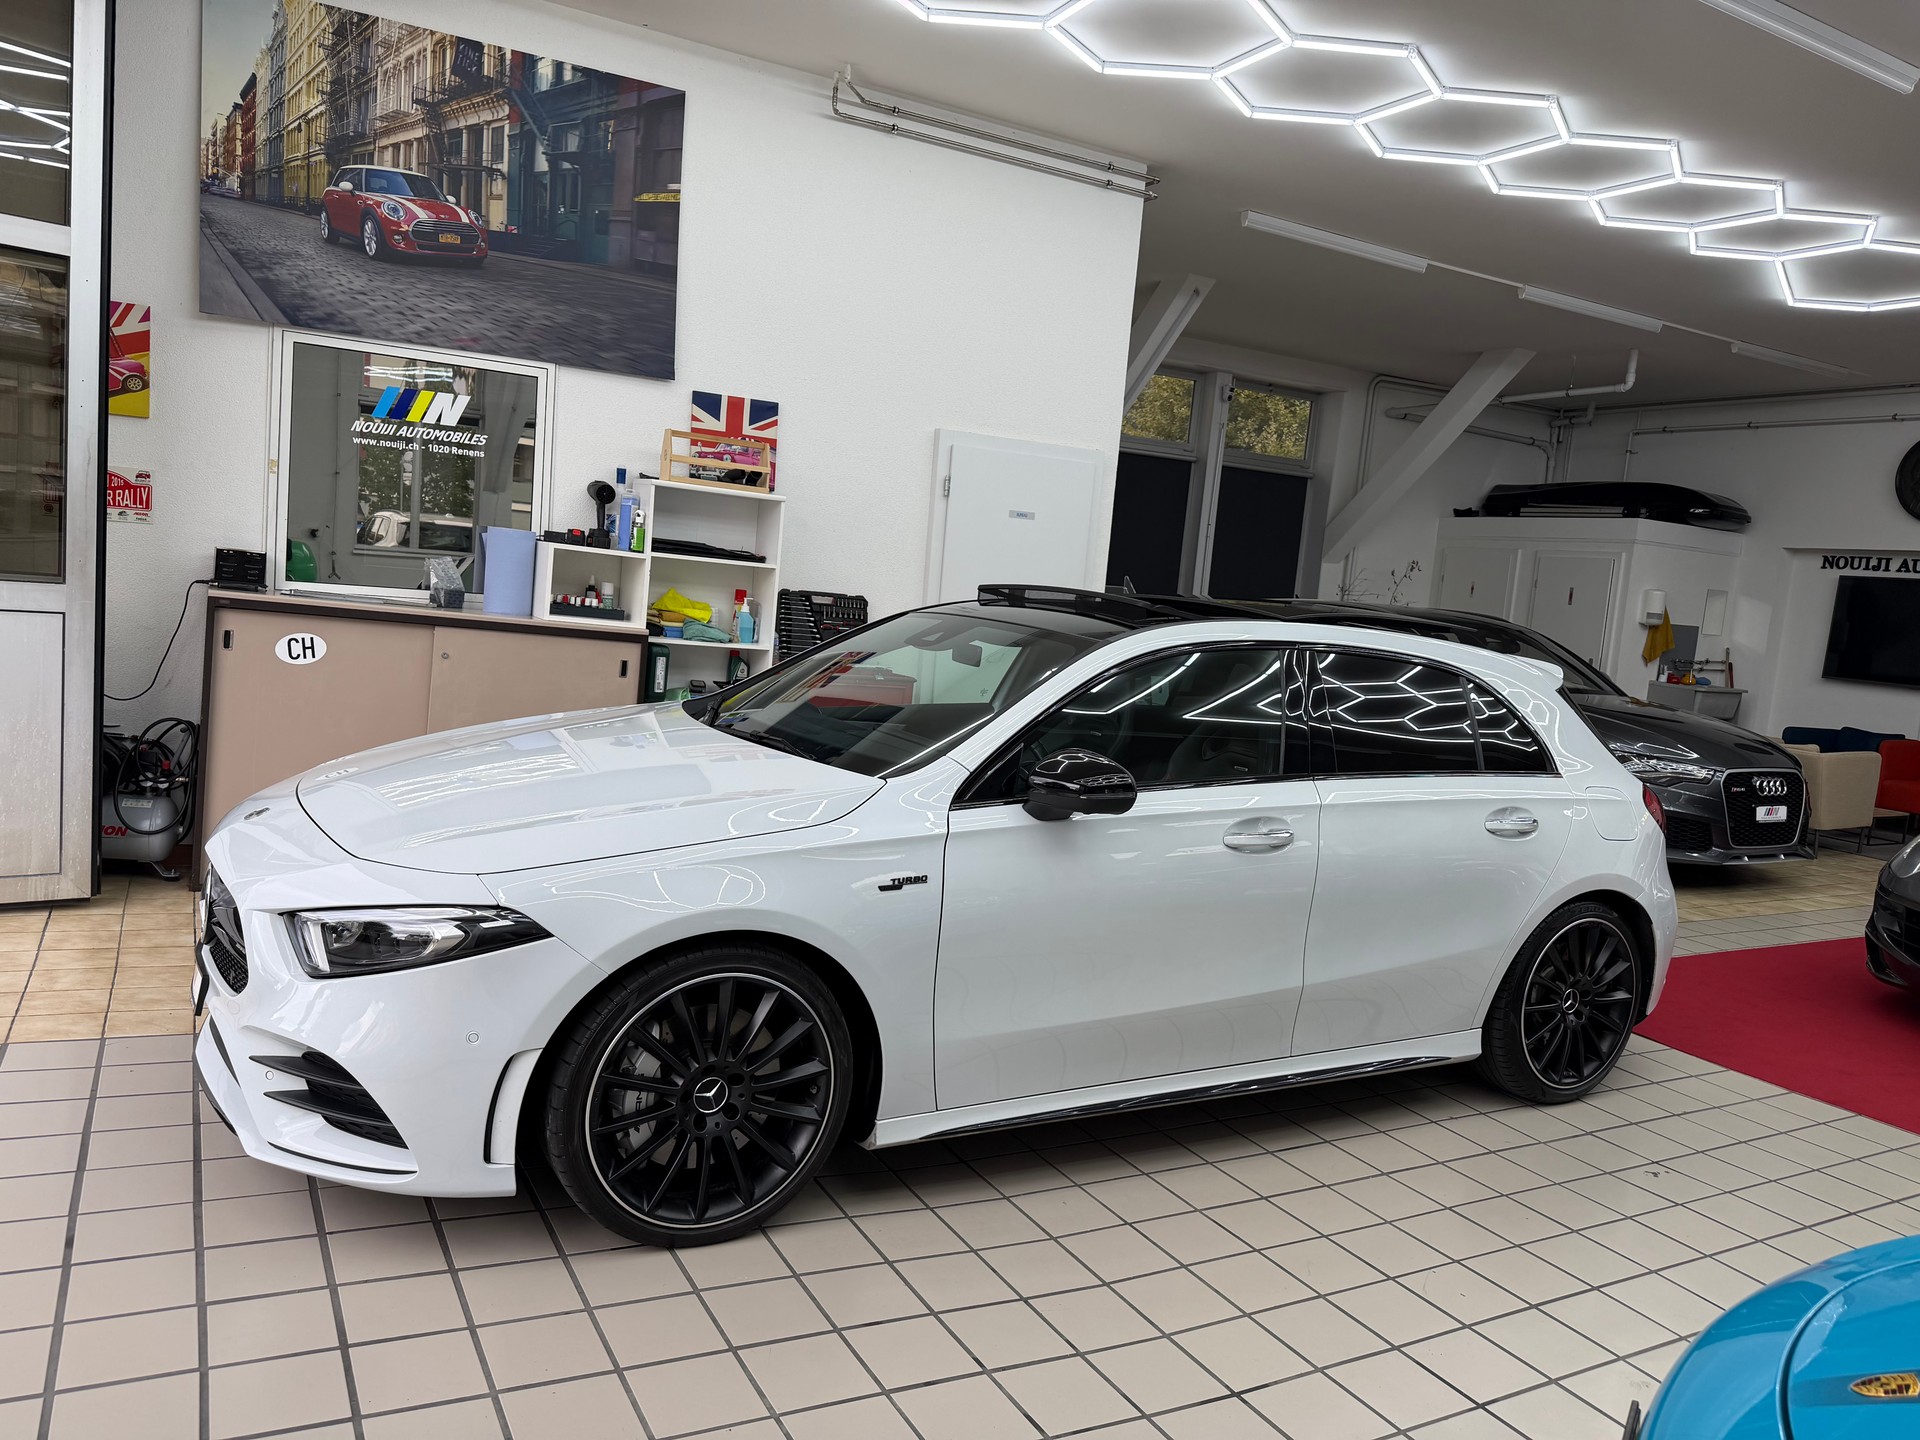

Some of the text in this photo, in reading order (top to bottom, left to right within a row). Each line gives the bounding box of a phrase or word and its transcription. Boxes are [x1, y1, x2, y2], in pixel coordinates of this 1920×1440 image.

[351, 420, 489, 446] NOUIJI AUTOMOBILES
[352, 436, 419, 450] www.nouiji.ch
[428, 444, 450, 454] 1020
[451, 446, 485, 458] Renens
[115, 487, 148, 508] RALLY
[1821, 555, 1893, 572] NOUIJI
[287, 636, 316, 660] CH
[890, 875, 928, 885] TURBO
